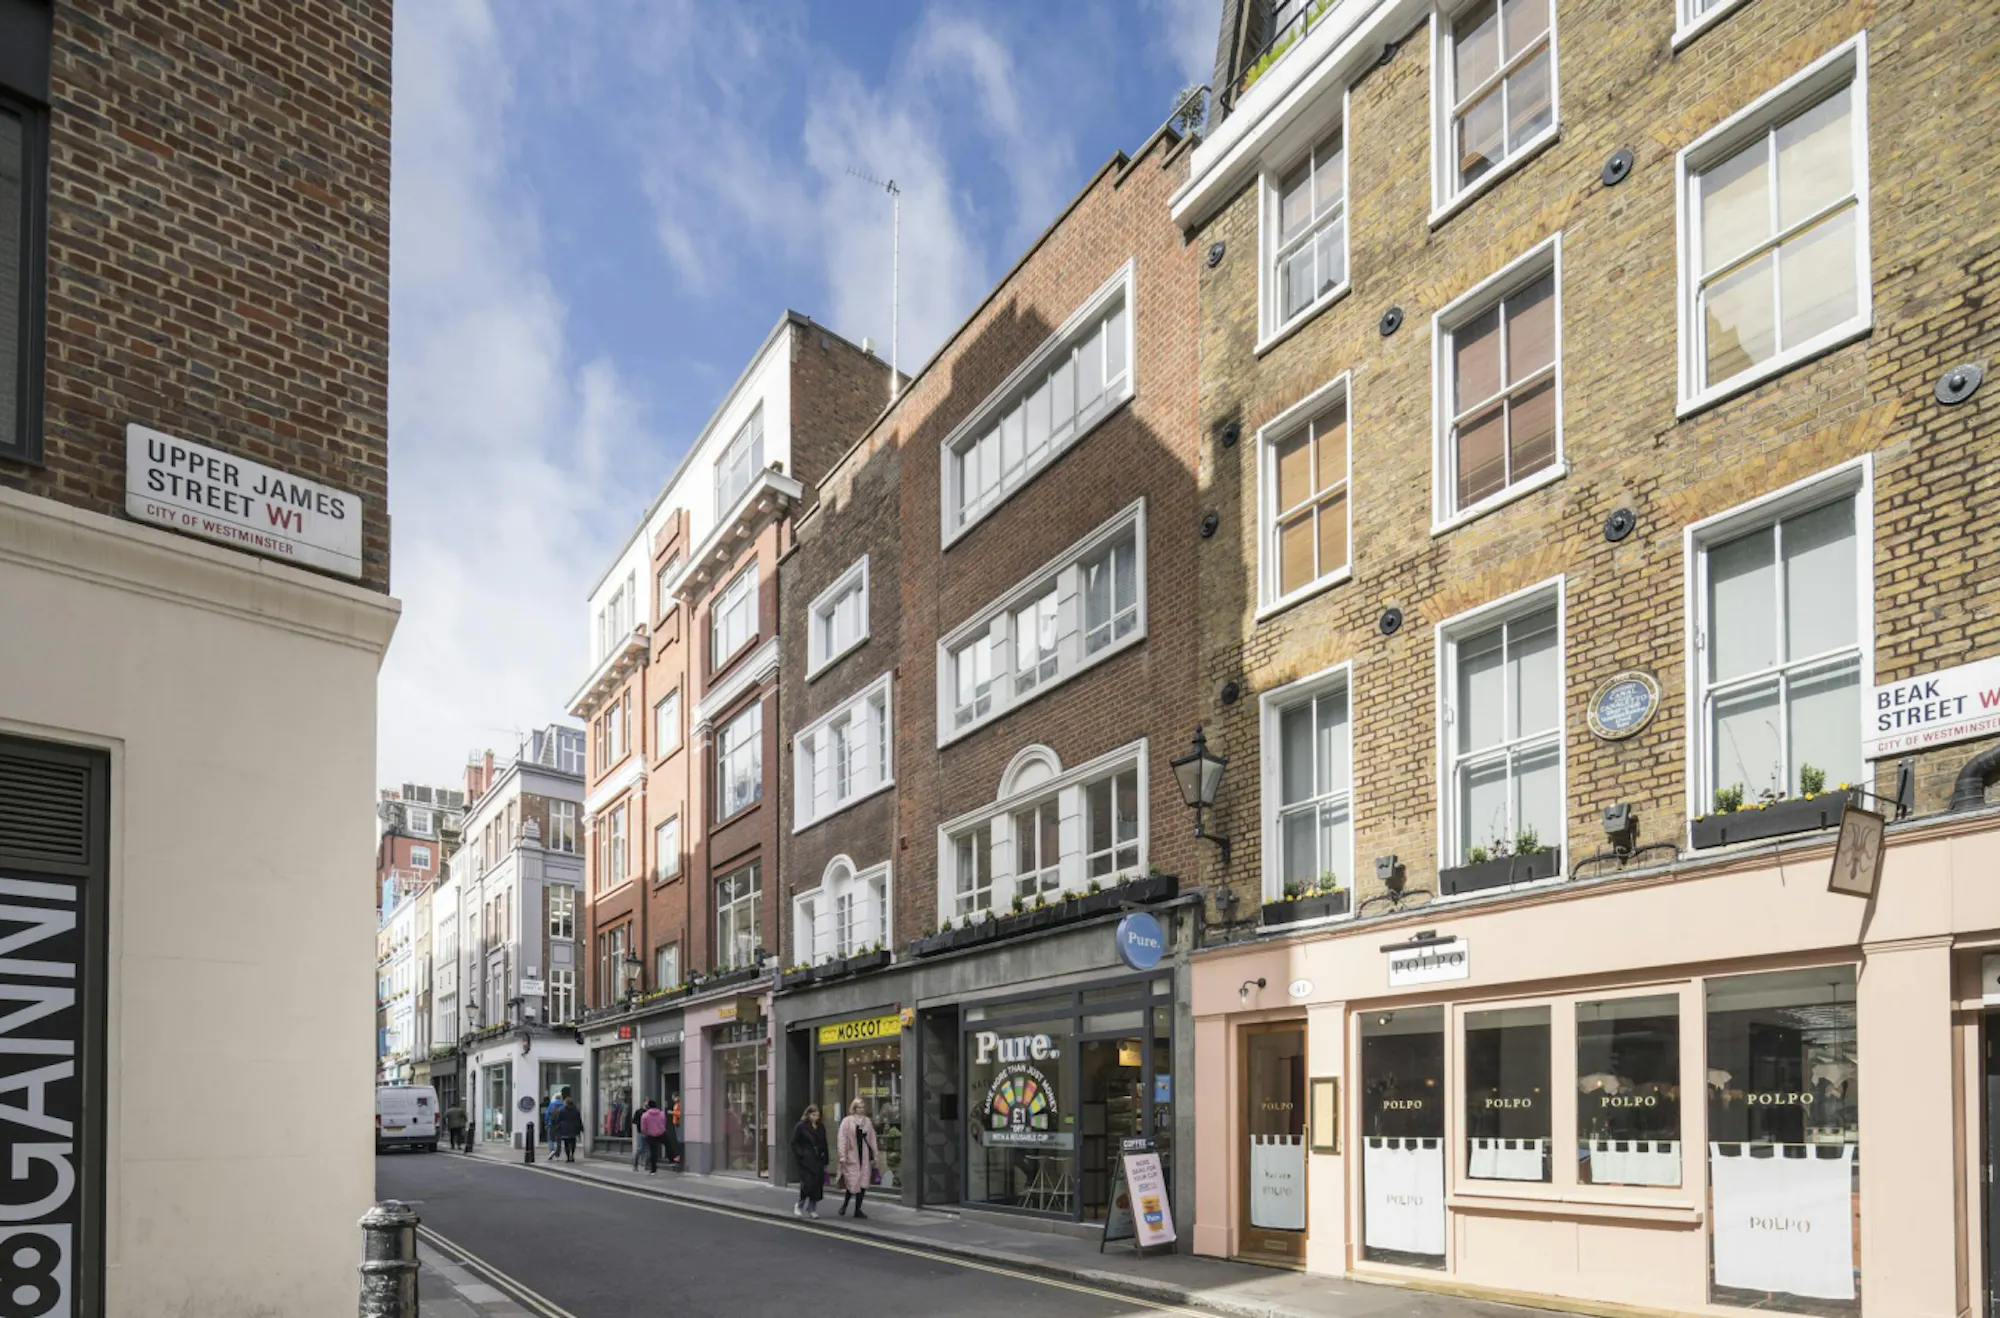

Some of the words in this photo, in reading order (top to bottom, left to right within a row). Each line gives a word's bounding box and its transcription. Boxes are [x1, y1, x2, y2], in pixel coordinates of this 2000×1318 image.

[148, 439, 239, 487] UPPER
[253, 475, 345, 520] JAMES
[147, 468, 254, 518] STREET
[265, 503, 303, 533] W1
[147, 504, 176, 521] CITY
[182, 513, 199, 527] OF
[203, 519, 294, 554] WESTMINSTER
[1877, 679, 1940, 710] BEAK
[1878, 695, 1968, 731] STREET
[1878, 740, 1901, 752] CITY
[1906, 736, 1919, 745] OF
[1128, 931, 1161, 949] Pure.
[1394, 952, 1464, 975] POLPO
[838, 1020, 881, 1040] MOSCOT
[975, 1031, 1060, 1065] Pure.
[984, 1090, 996, 1115] SAVE
[991, 1069, 1008, 1091] MORE
[1007, 1063, 1026, 1074] THAN
[1027, 1065, 1044, 1082] JUST
[1041, 1080, 1058, 1114] MONEY
[1261, 1102, 1294, 1110] POLPO
[1383, 1100, 1423, 1109] POLPO
[1485, 1099, 1532, 1109] POLPO
[1601, 1096, 1657, 1107] POLPO
[1747, 1093, 1814, 1105] POLPO
[1012, 1107, 1026, 1124] £1
[1123, 1139, 1147, 1149] COFFEE
[1387, 1194, 1424, 1206] POLPO
[1750, 1216, 1811, 1233] POLPO
